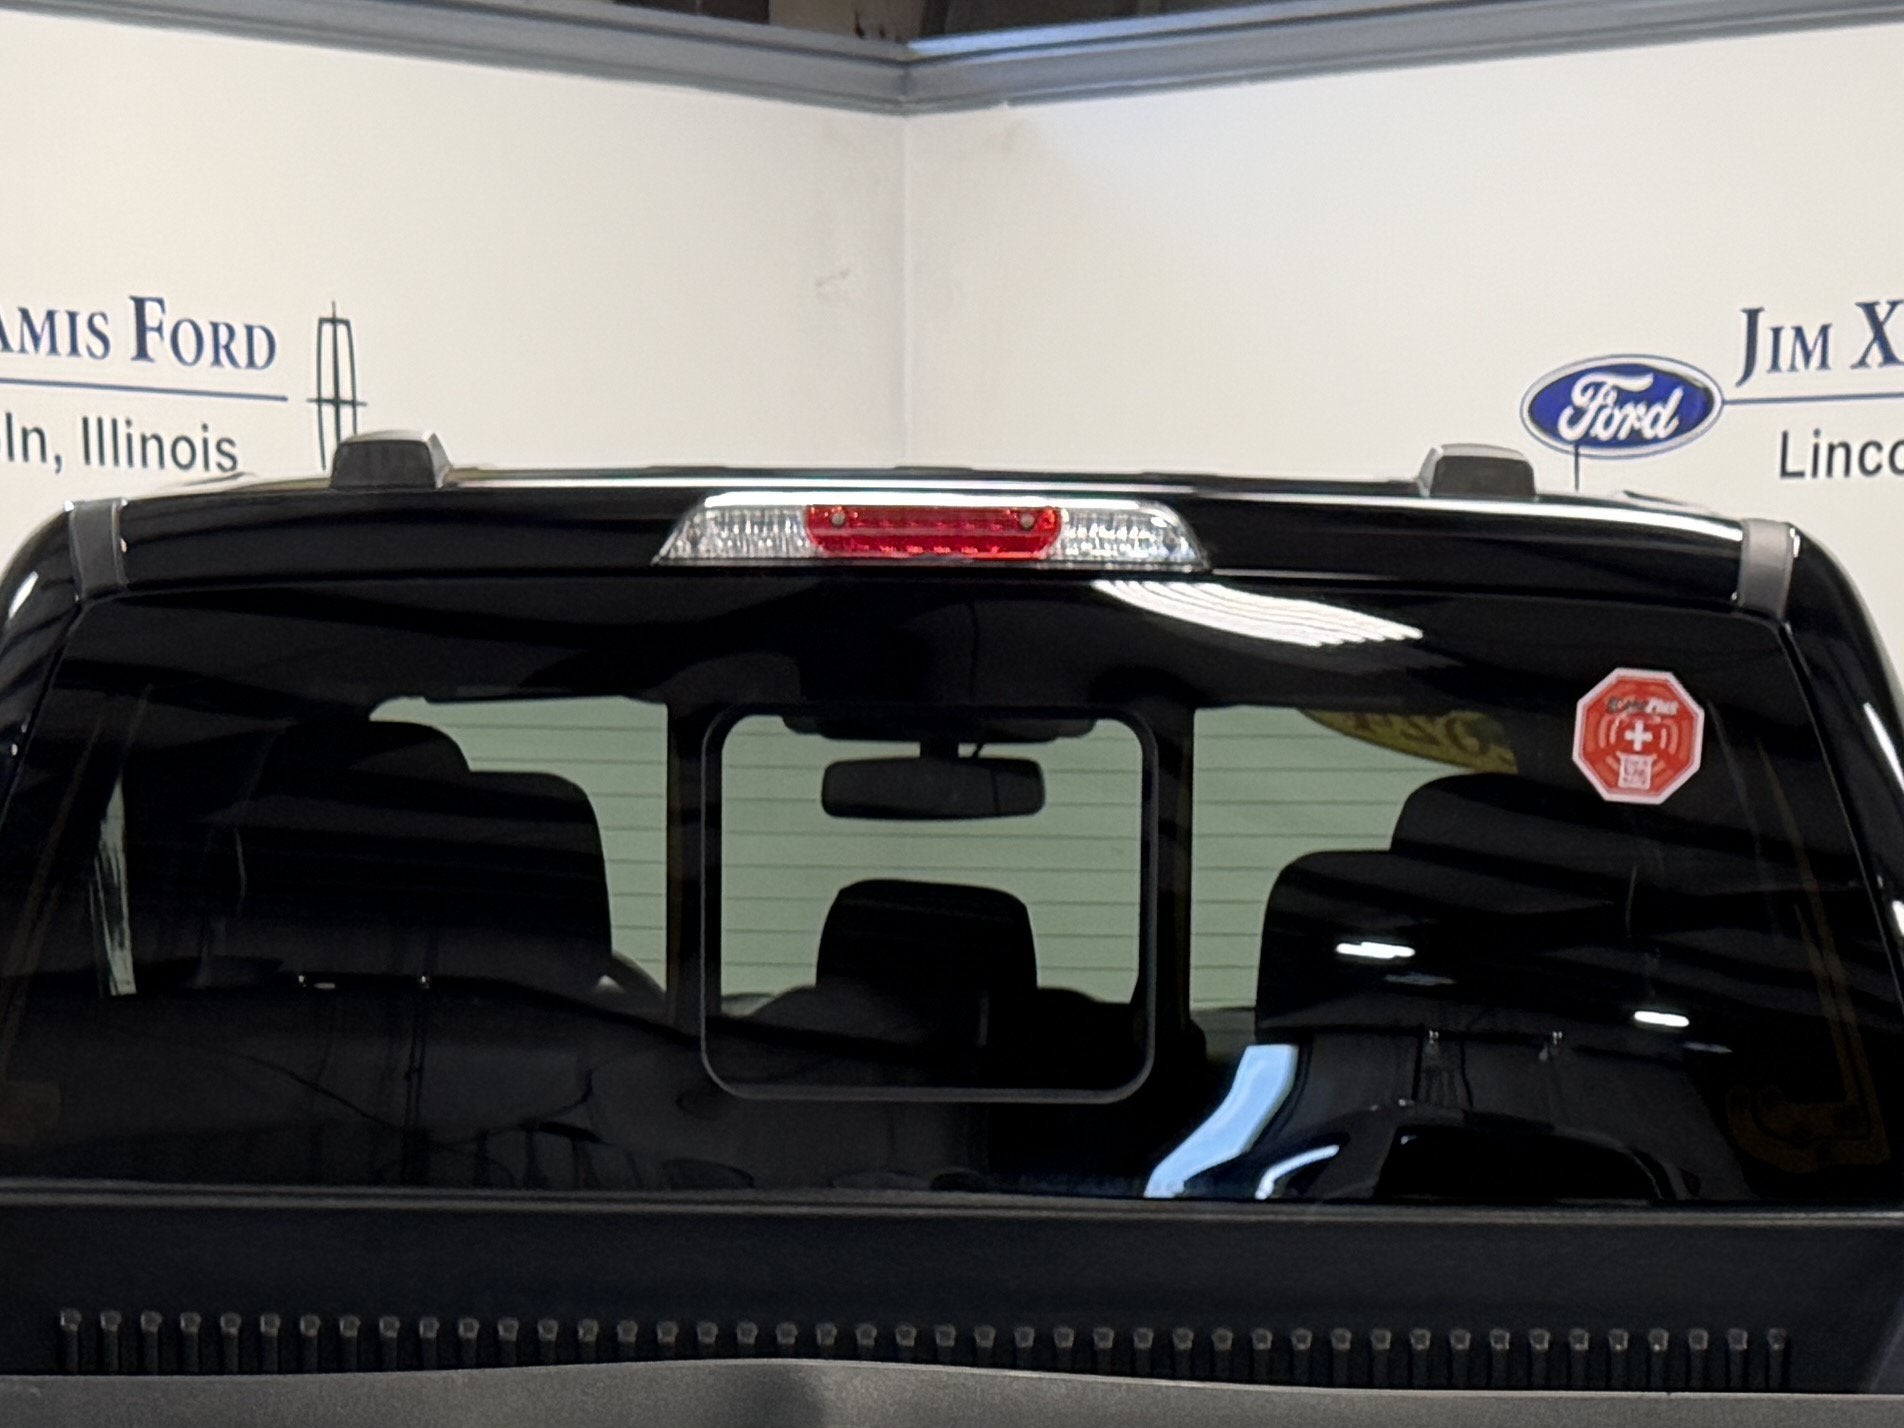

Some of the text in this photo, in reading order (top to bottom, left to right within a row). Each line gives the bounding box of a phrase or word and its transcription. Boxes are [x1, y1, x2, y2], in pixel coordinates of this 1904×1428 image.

[129, 295, 276, 370] FORD
[1735, 306, 1832, 388] JIM
[1557, 371, 1685, 443] Ford
[81, 415, 239, 474] Illinois
